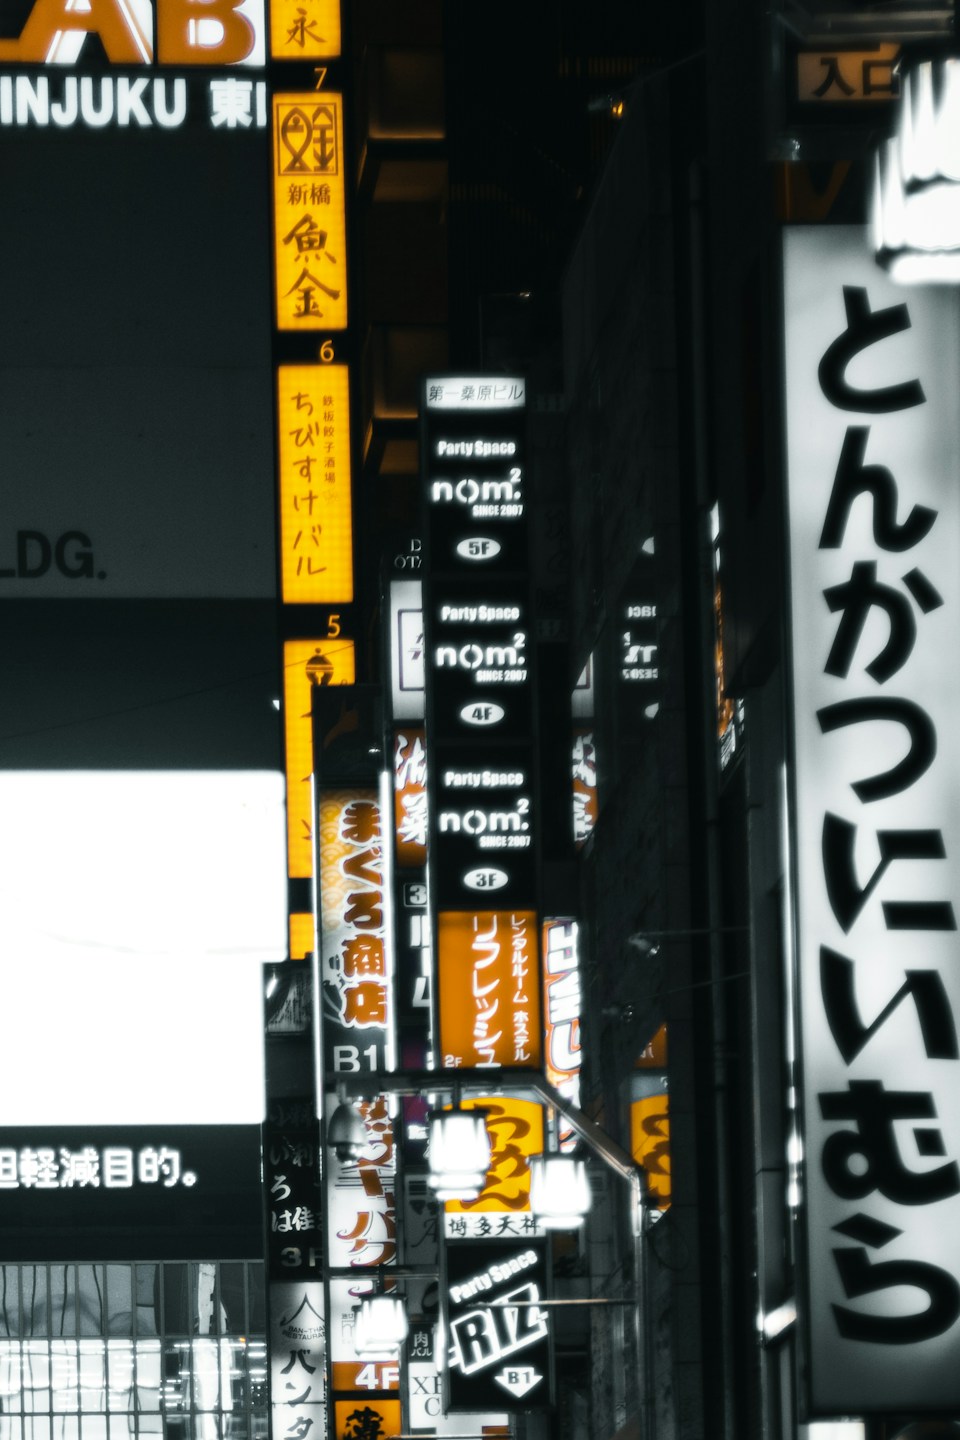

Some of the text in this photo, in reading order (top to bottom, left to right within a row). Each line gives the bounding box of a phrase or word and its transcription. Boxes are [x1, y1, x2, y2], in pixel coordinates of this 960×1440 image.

[314, 67, 328, 90] 7
[210, 78, 266, 127] 東
[286, 183, 331, 206] 新橋
[282, 213, 340, 318] 魚金
[319, 340, 335, 362] 6
[429, 384, 524, 402] 第一桑原ビル
[322, 395, 336, 484] 鉄板餃子酒場
[438, 440, 516, 457] Party Space
[289, 392, 328, 577] ちびすけバル
[473, 504, 524, 517] SINCE 2007
[468, 541, 491, 556] 5F
[442, 605, 520, 622] Party Space
[326, 615, 341, 637] 5
[476, 669, 527, 682] SINCE 2007
[471, 706, 493, 721] 4F
[445, 771, 523, 788] Party Space
[816, 284, 960, 1346] とんかつにいむら
[479, 835, 531, 848] SINCE 2007
[475, 872, 497, 887] 3F
[471, 914, 502, 1068] リフレッシュ
[511, 914, 530, 1062] レンタルルーム ホステル
[444, 1055, 462, 1068] 2F
[449, 1249, 539, 1304] Party Space
[354, 1363, 399, 1390] 4F
[507, 1371, 530, 1385] B1
